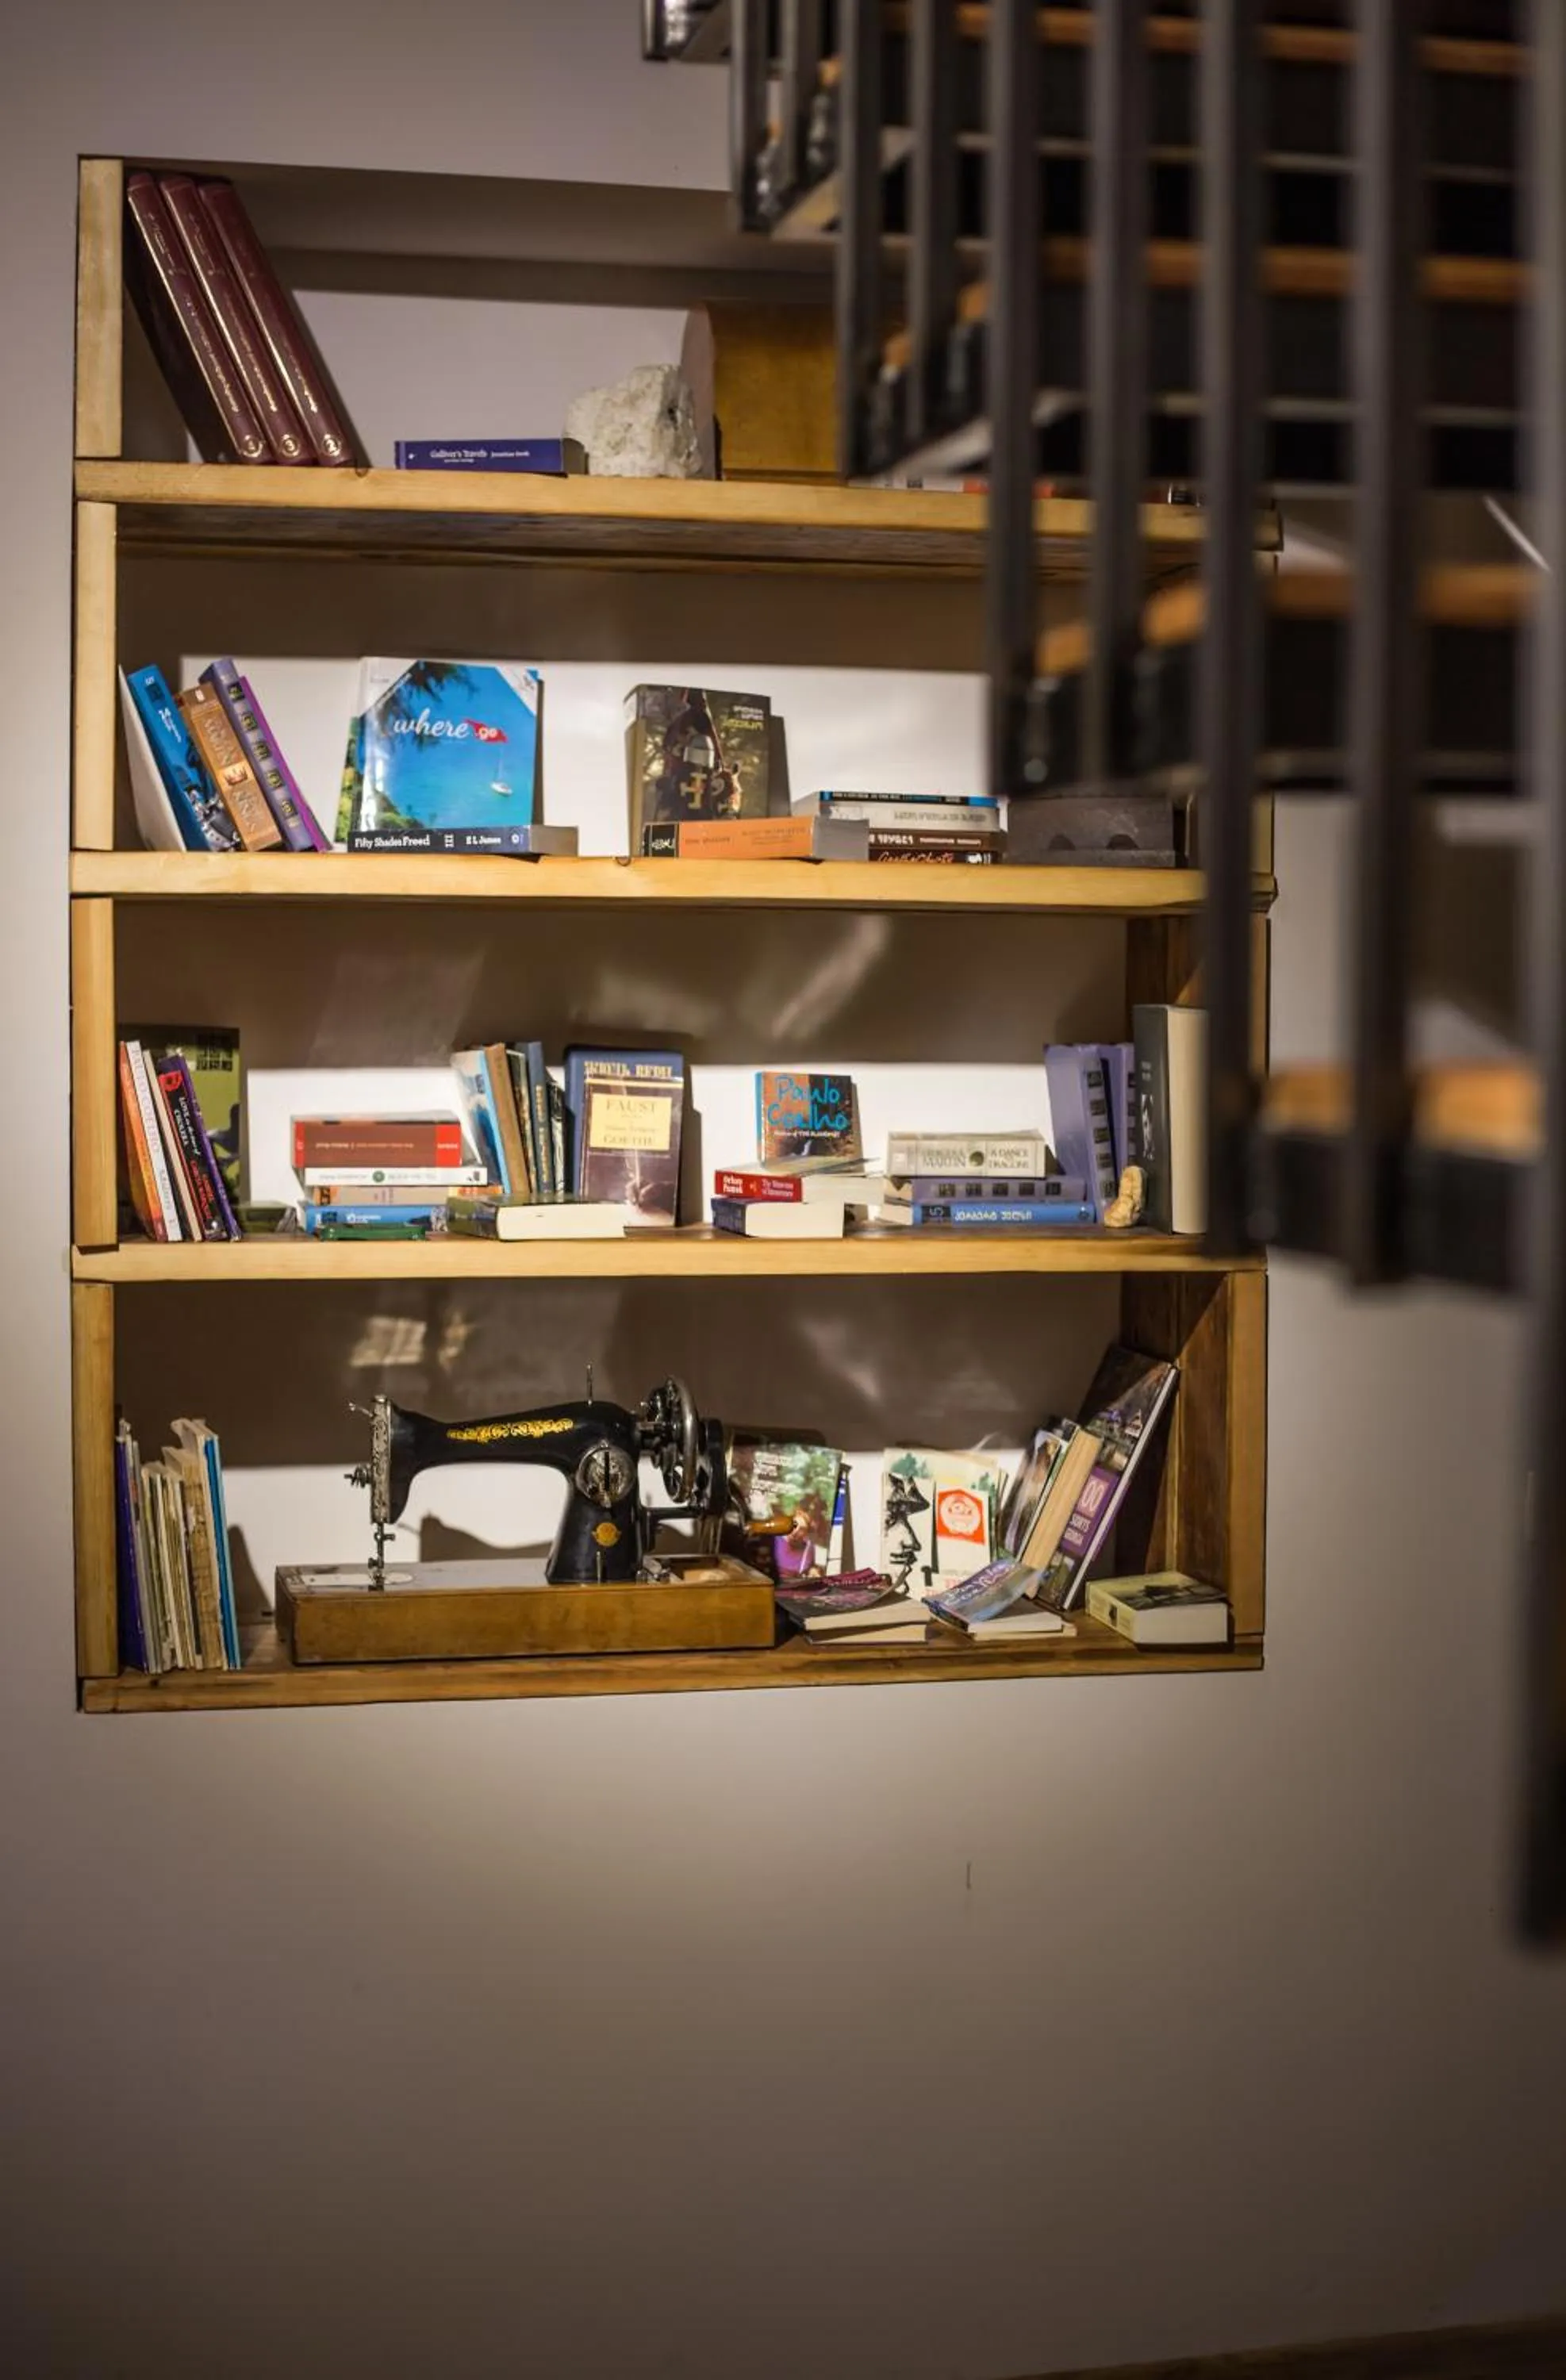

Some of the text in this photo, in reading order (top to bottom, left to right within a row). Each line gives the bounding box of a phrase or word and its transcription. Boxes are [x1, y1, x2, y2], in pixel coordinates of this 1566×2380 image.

[393, 708, 498, 740] where go
[355, 834, 430, 850] Fifty Shades Freed
[479, 835, 501, 845] James
[776, 1075, 840, 1104] Paulo
[605, 1098, 657, 1113] FAUST
[767, 1102, 850, 1130] Coelho
[724, 1174, 743, 1184] Orhan
